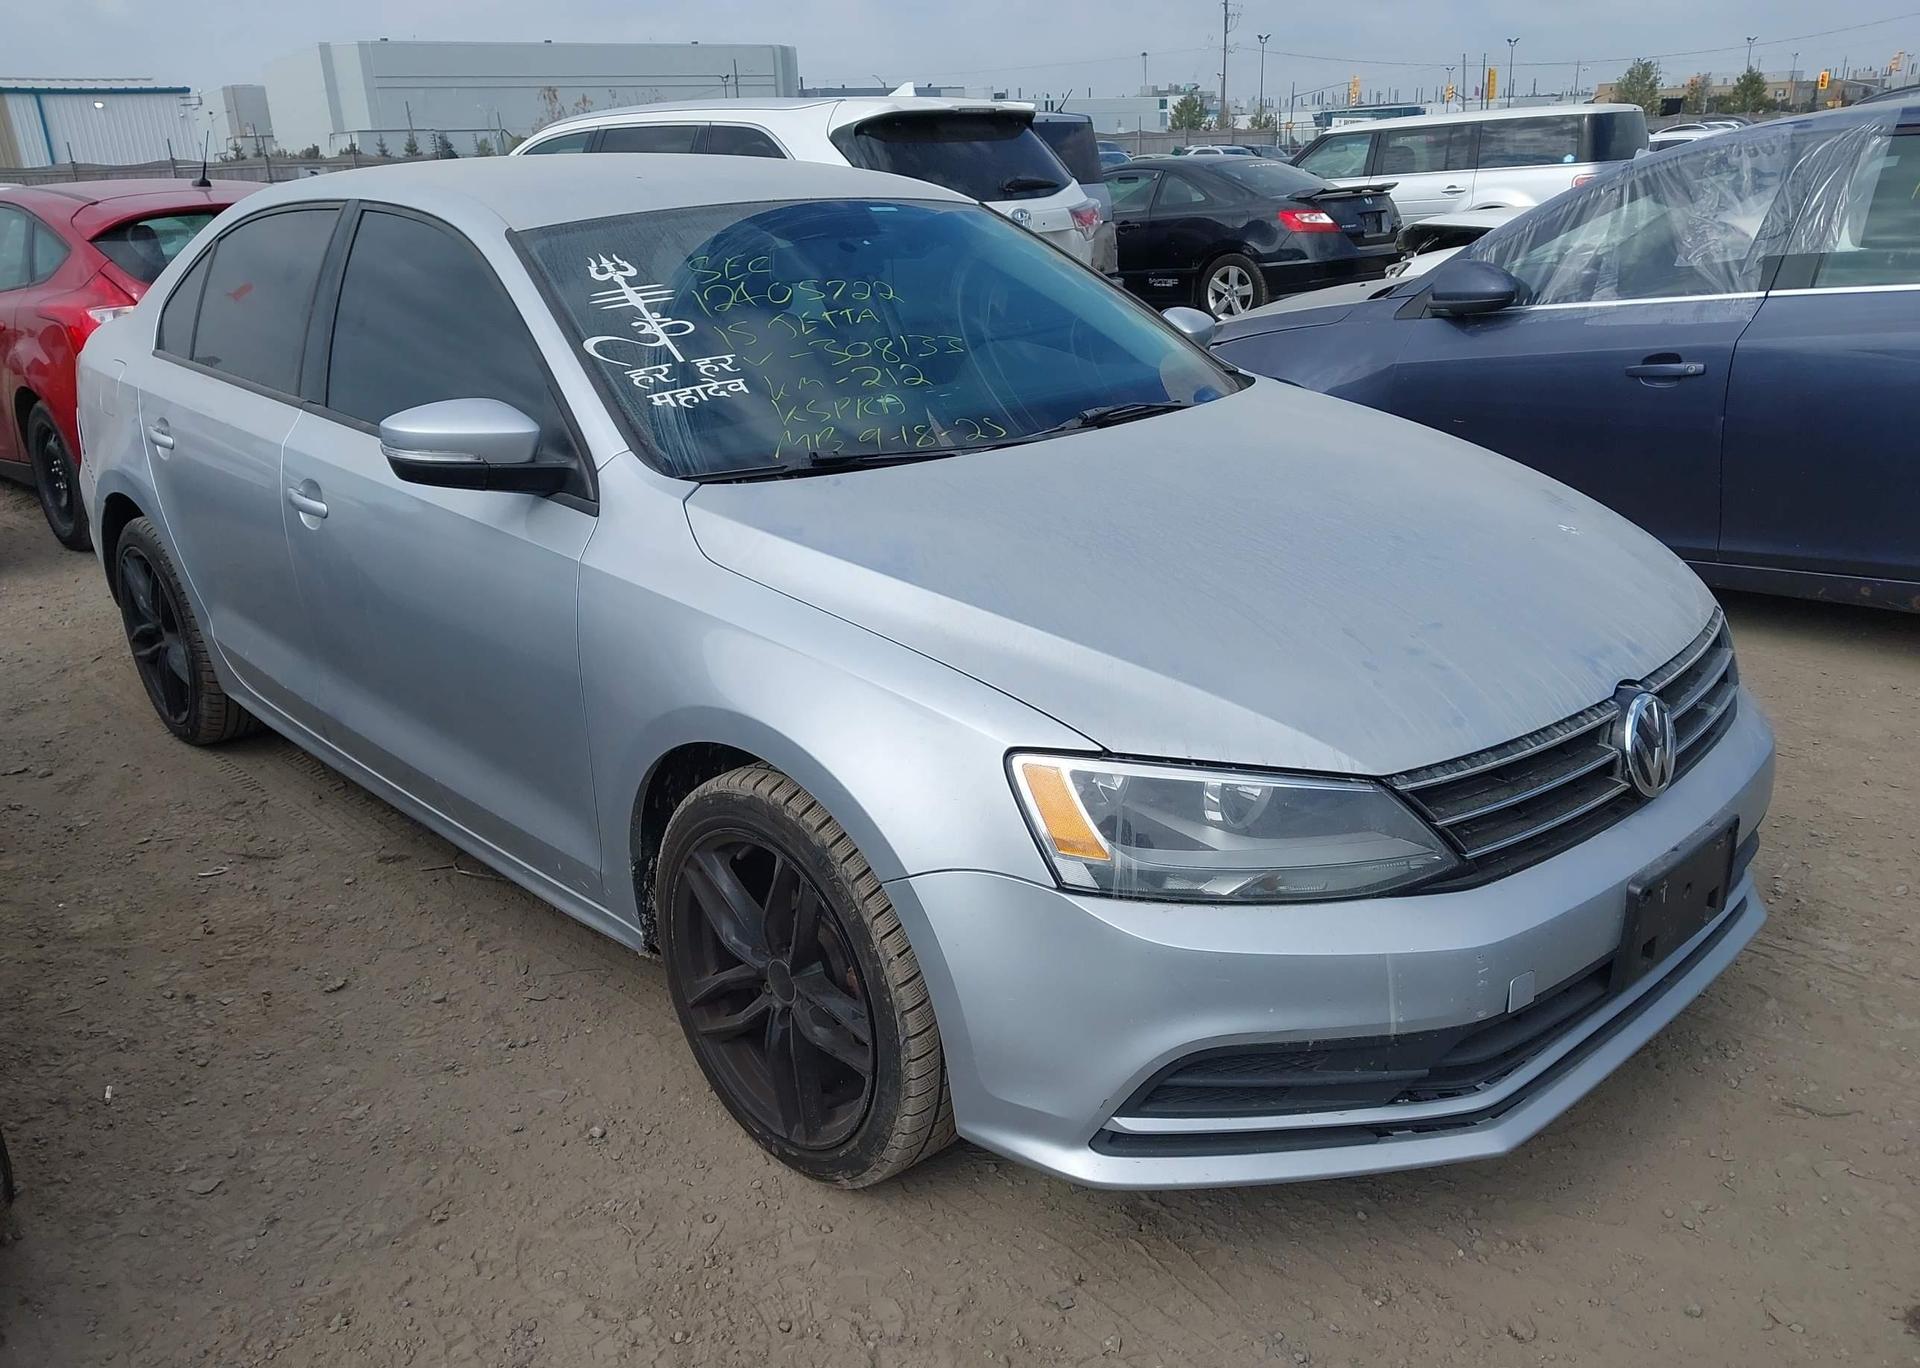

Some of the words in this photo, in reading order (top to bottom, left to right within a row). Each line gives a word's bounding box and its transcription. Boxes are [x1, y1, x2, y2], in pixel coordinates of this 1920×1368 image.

[767, 308, 880, 340] JETTA
[624, 363, 677, 390] हर
[690, 353, 742, 378] हर
[646, 377, 750, 408] महादेव
